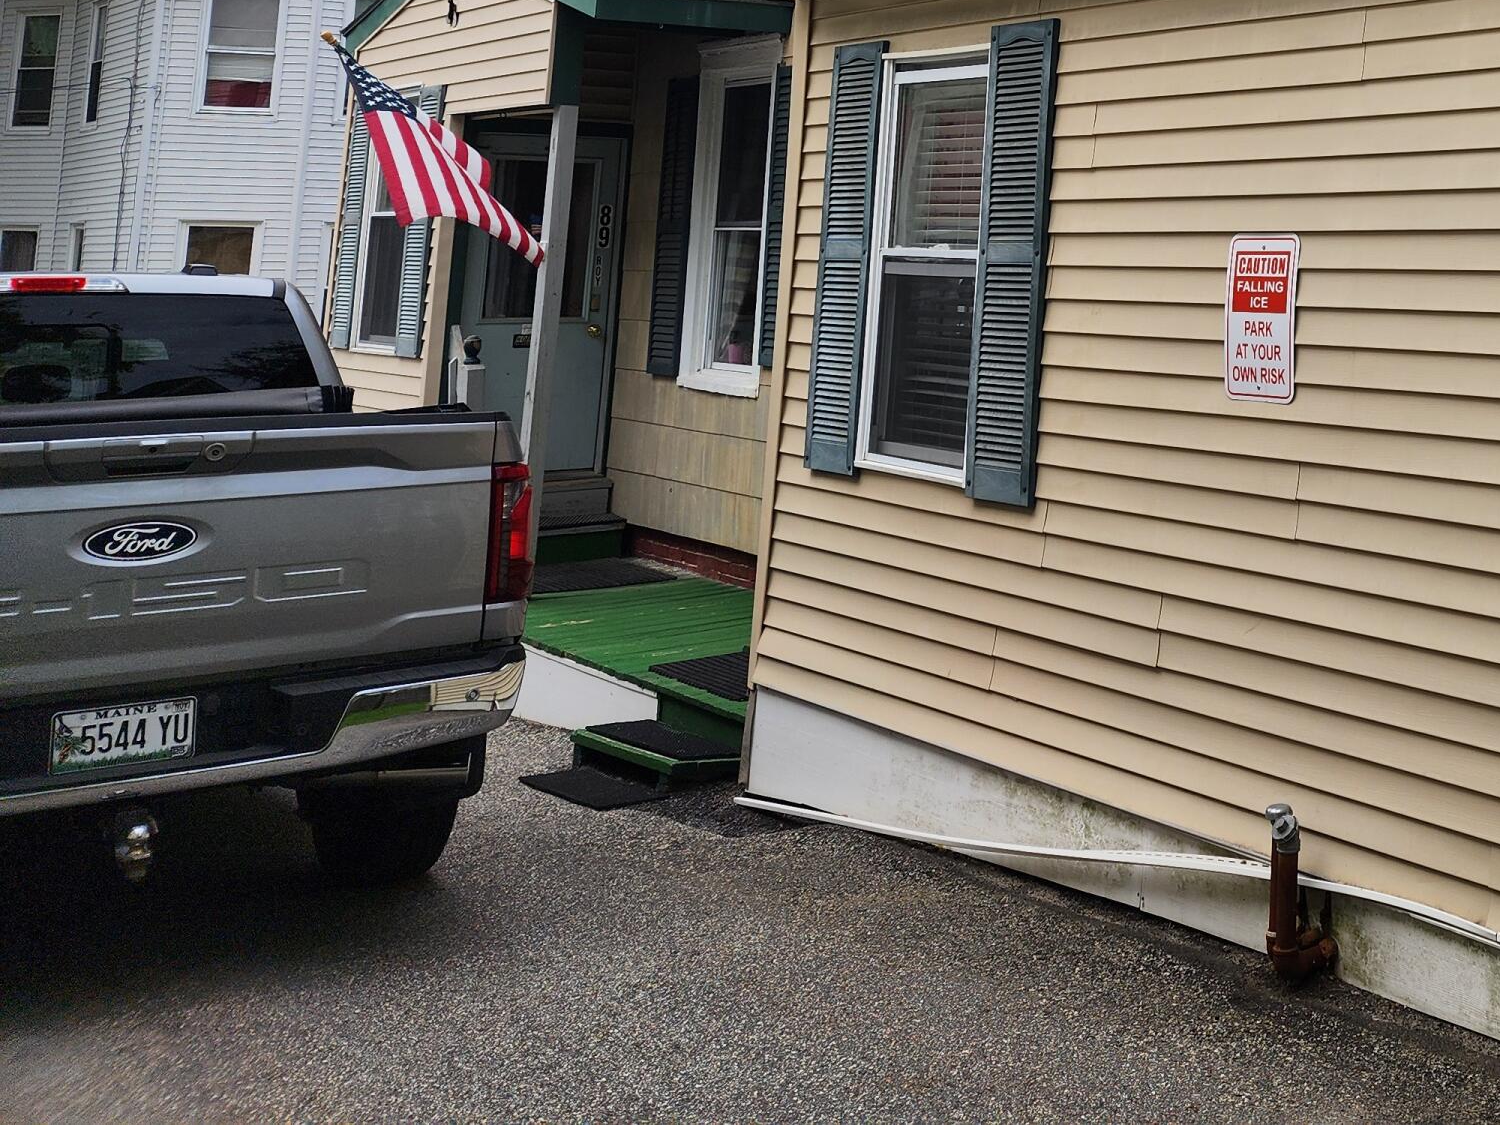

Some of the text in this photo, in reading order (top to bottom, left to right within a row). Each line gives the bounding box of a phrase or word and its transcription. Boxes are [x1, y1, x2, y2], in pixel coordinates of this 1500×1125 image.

[599, 205, 611, 248] 89
[1239, 257, 1286, 275] CAUTION
[1237, 280, 1284, 293] FALLING
[1250, 297, 1268, 309] ICE
[1244, 321, 1273, 337] PARK
[1235, 344, 1281, 361] AT YOUR
[1232, 366, 1285, 385] OWN RISK
[104, 527, 178, 555] Ford
[95, 704, 157, 720] MAINE
[80, 713, 189, 755] 5544 YU
